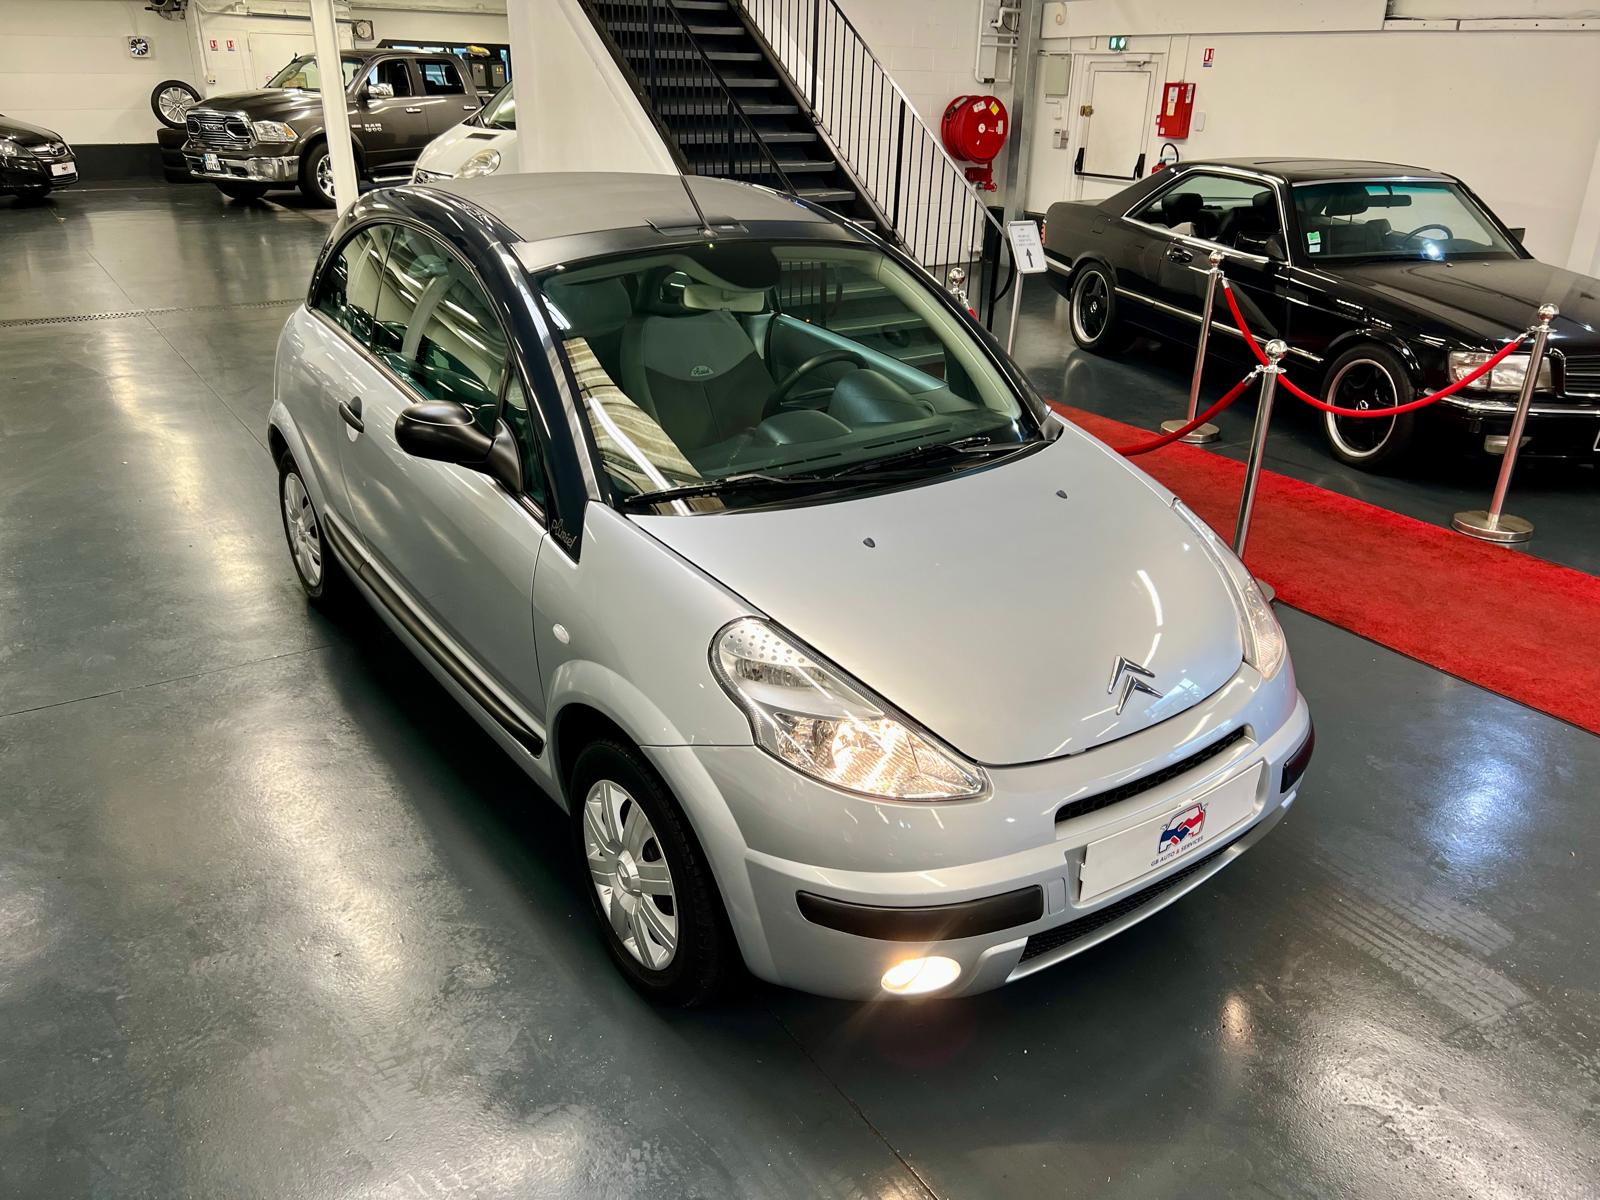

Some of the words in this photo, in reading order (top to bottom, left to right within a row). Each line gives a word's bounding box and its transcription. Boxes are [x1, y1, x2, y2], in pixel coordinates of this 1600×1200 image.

[1151, 859, 1159, 867] GB
[1160, 852, 1175, 863] AUTO
[1181, 836, 1204, 852] SERVICES
